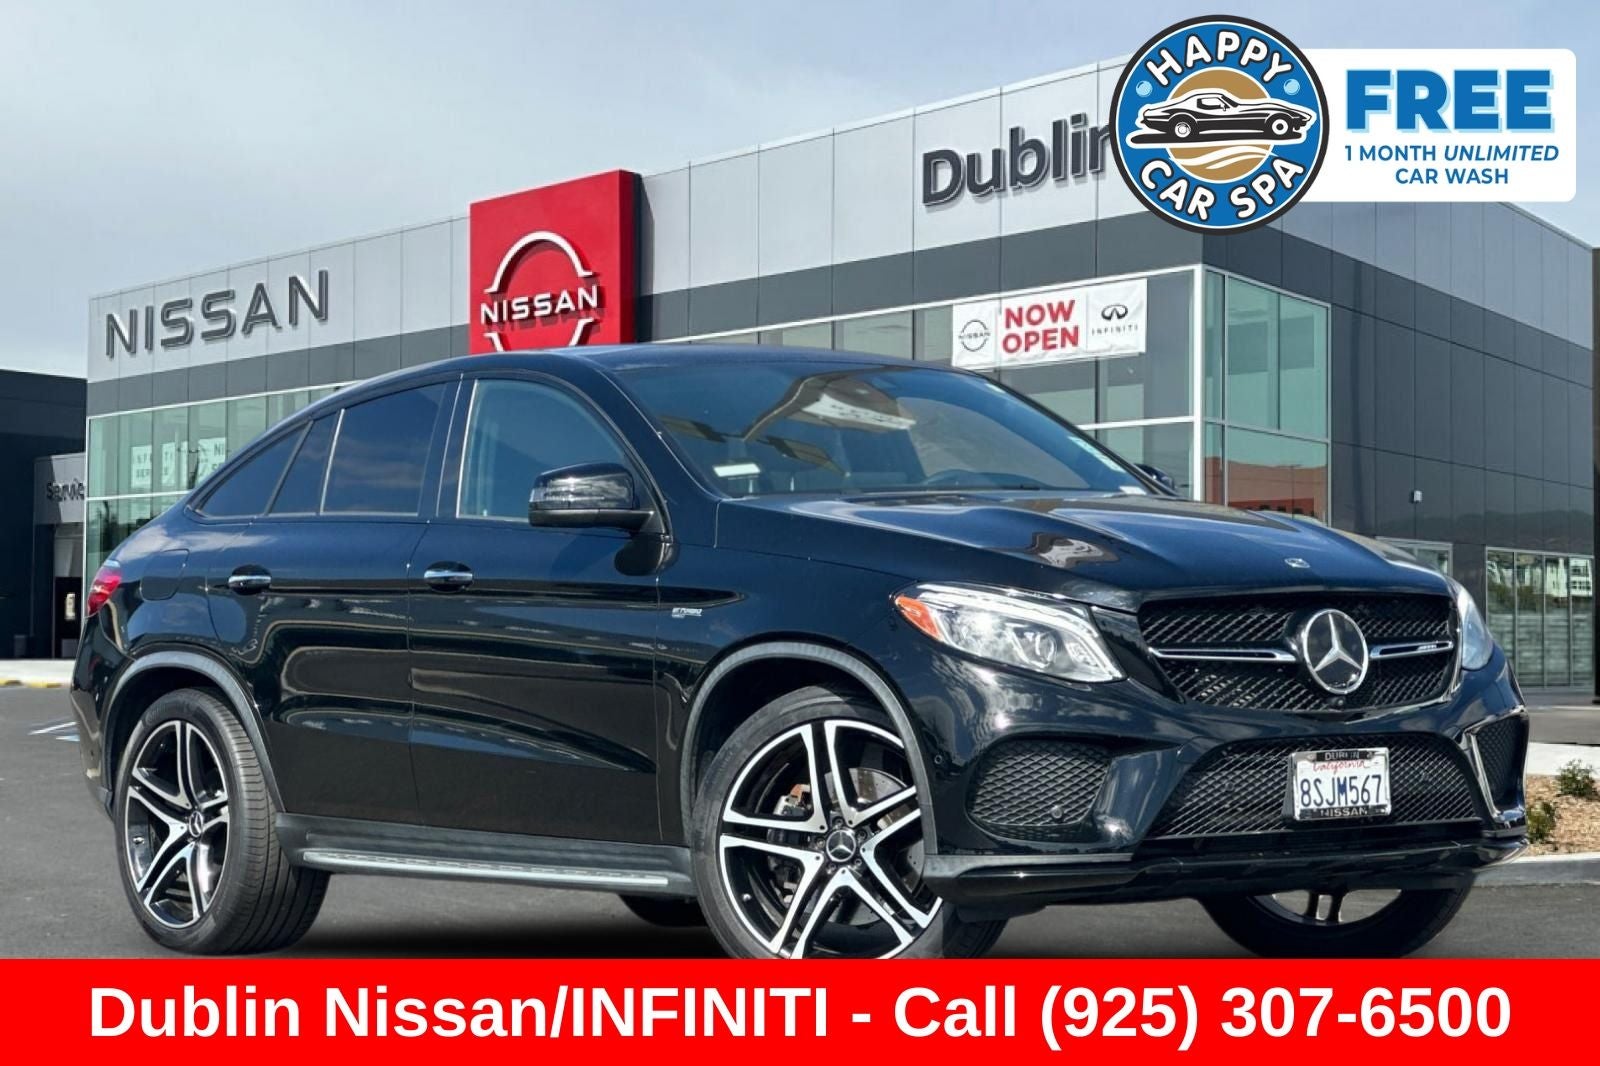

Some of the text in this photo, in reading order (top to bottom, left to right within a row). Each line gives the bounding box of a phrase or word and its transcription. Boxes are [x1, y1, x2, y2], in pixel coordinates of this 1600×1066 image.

[105, 269, 330, 359] NISSAN
[480, 285, 598, 325] NISSAN
[1005, 300, 1075, 328] NOW
[1002, 326, 1080, 353] OPEN
[1300, 774, 1382, 807] 8SJM567
